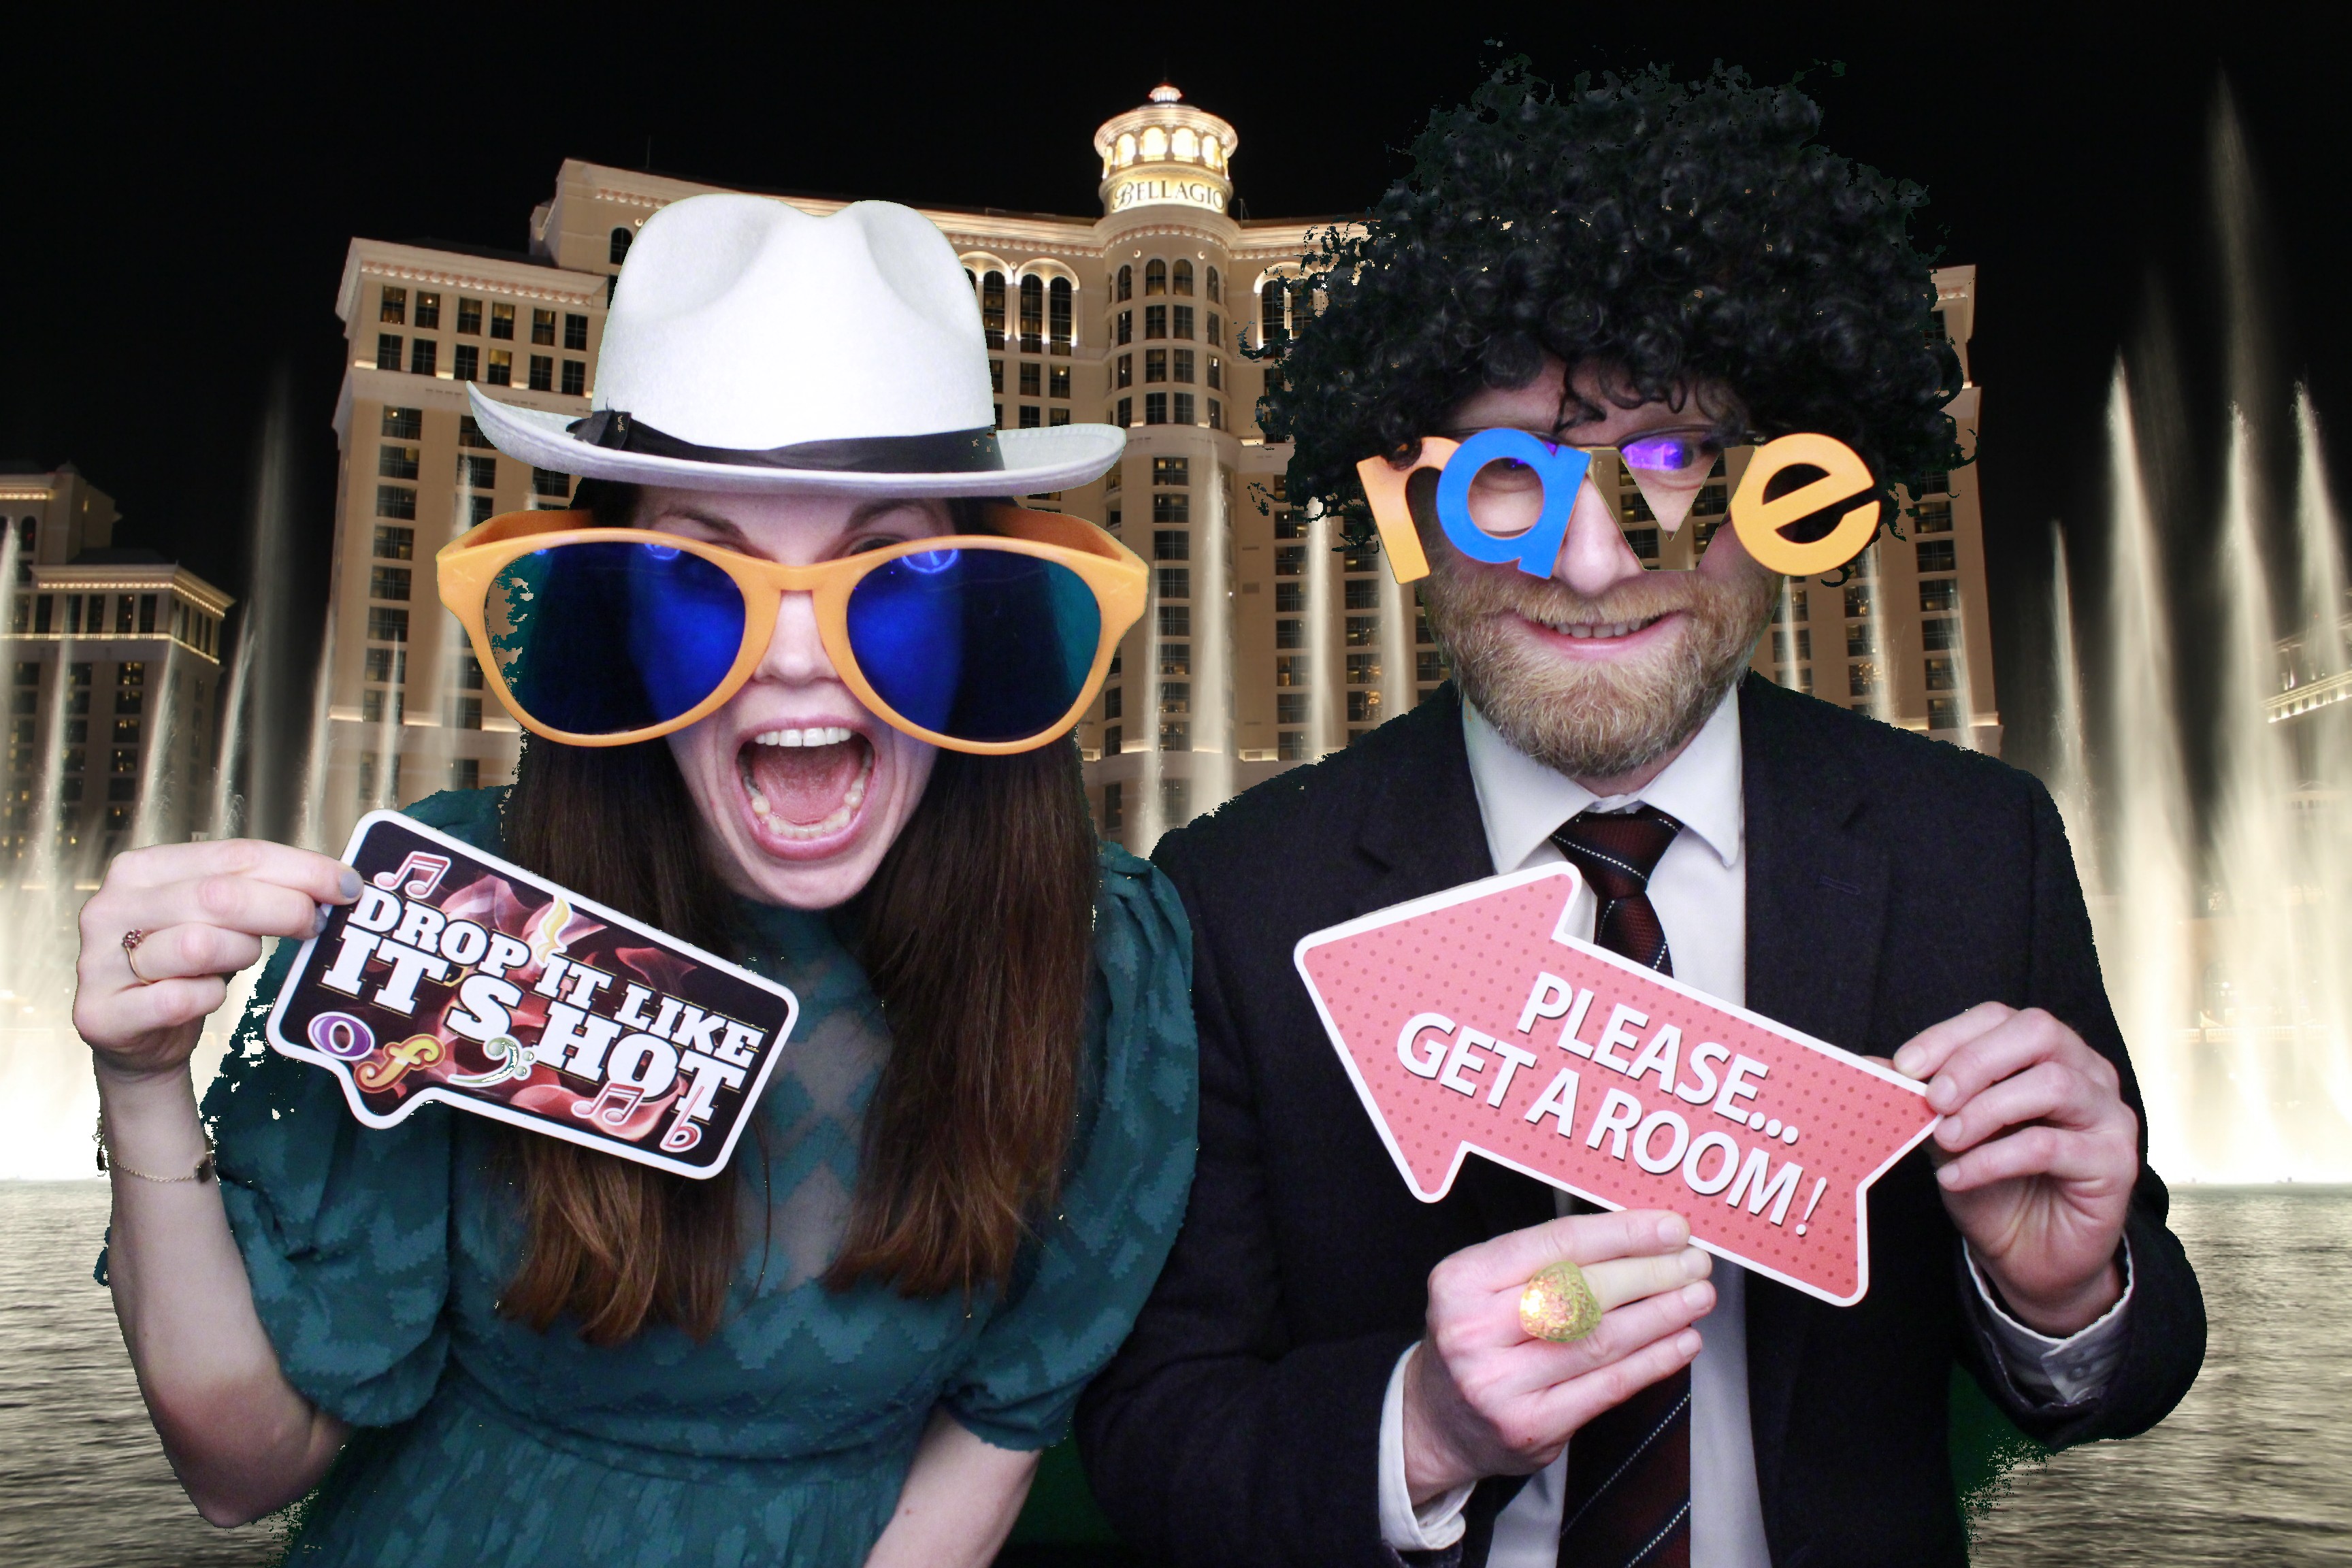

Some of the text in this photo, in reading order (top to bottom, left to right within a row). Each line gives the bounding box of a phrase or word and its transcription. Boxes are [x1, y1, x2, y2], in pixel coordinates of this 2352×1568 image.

[1111, 180, 1225, 209] BELLAGIO
[348, 886, 766, 1065] DROP IT LIKE
[533, 1002, 749, 1122] HOT
[1517, 972, 1799, 1145] PLEASE...
[1396, 1013, 1827, 1235] GET A ROOM!
